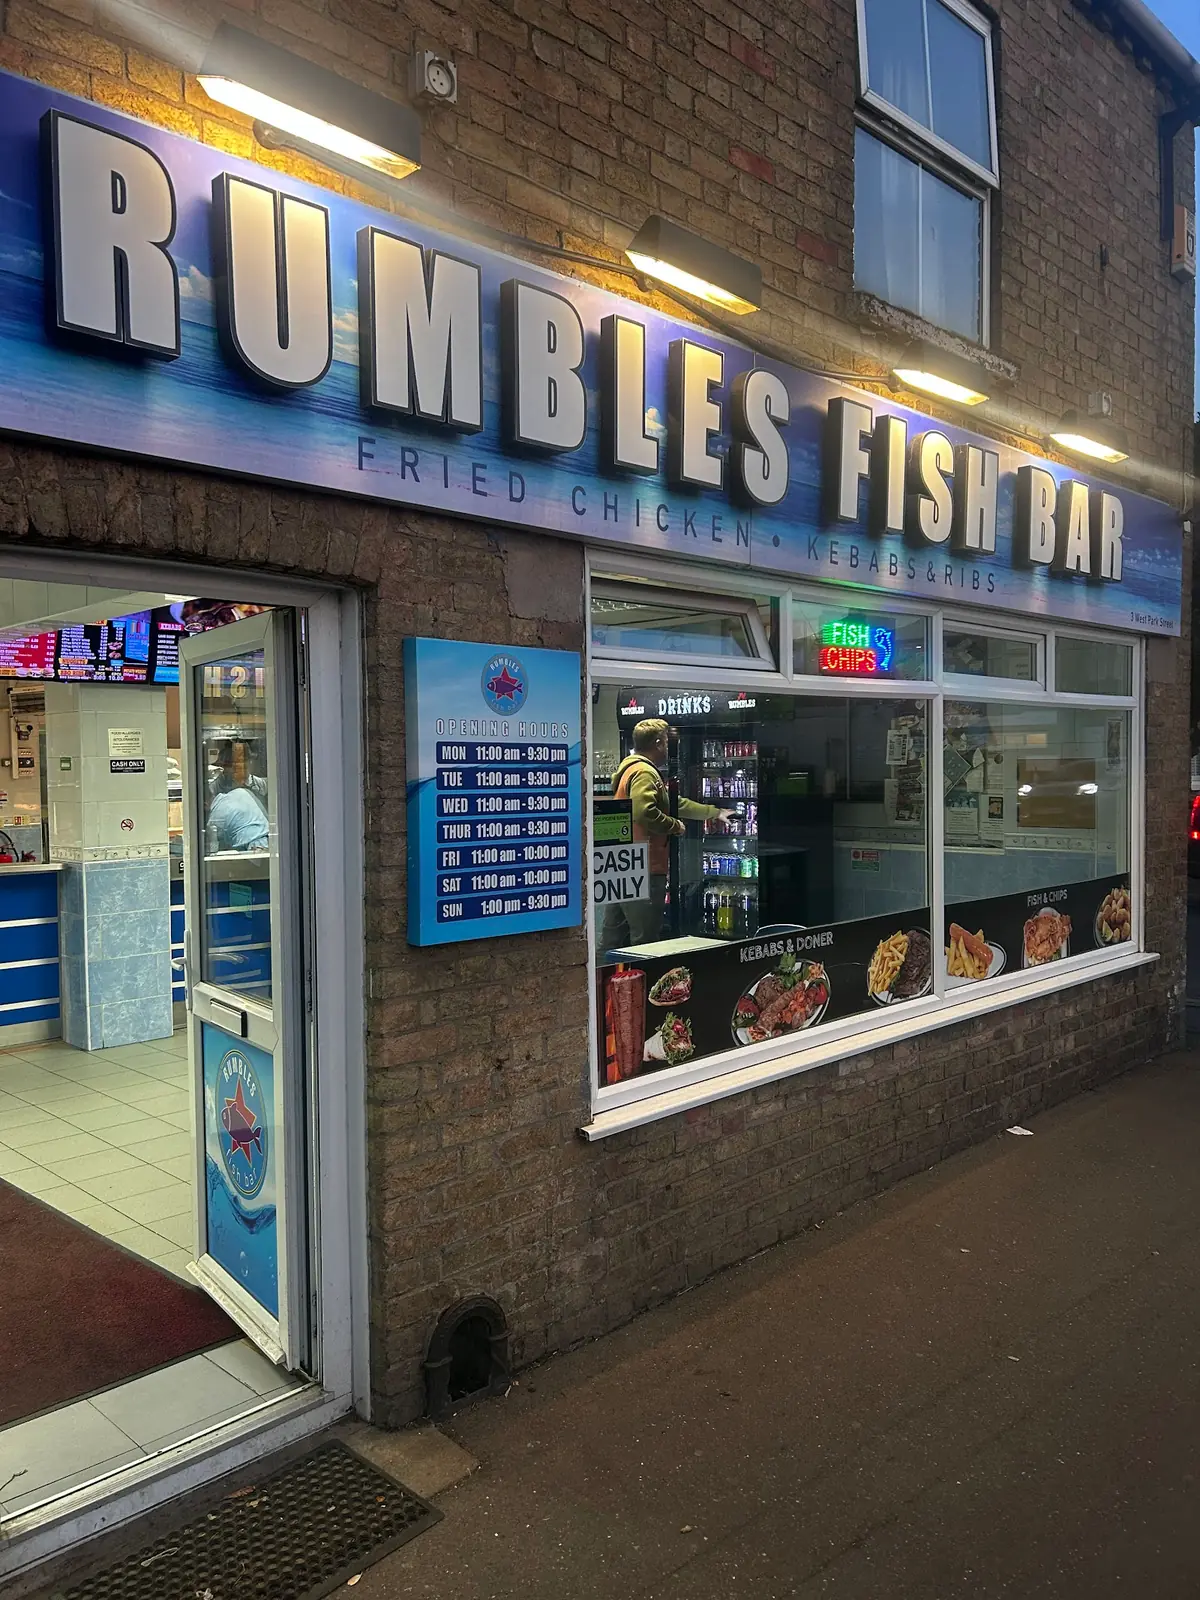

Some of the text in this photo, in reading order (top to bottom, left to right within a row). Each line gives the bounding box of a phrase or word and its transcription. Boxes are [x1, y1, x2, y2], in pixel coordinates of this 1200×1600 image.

[40, 108, 1124, 582] RUMBLES FISH BAR
[357, 436, 750, 548] FRIED CHICKEN
[1130, 611, 1174, 629] 3 West Park Street
[832, 622, 870, 648] FISH
[490, 658, 519, 672] RUMBLES
[826, 647, 877, 671] CHIPS
[621, 706, 645, 716] RUMBLES
[658, 695, 711, 716] DRINKS
[728, 699, 756, 710] RUMBLES
[436, 718, 569, 738] OPENING HOURS
[442, 746, 466, 761] MON
[476, 746, 502, 761] 11:00
[504, 748, 520, 760] am
[528, 746, 549, 761] 9:30
[551, 748, 566, 762] pm
[442, 772, 462, 787] TUE
[476, 772, 502, 786] 11:00
[504, 774, 520, 785] am
[528, 772, 549, 785] 9:30
[551, 773, 566, 786] pm
[443, 798, 468, 813] WED
[476, 797, 502, 812] 11:00
[504, 799, 520, 811] am
[528, 796, 549, 810] 9:30
[551, 798, 566, 811] pm
[443, 824, 471, 839] THUR
[476, 823, 502, 837] 11:00
[504, 824, 520, 836] am
[528, 821, 549, 835] 9:30
[551, 822, 566, 835] pm
[442, 851, 460, 866] FRI
[472, 849, 498, 864] 11:00
[500, 850, 516, 862] am
[524, 846, 549, 861] 10:00
[551, 846, 566, 860] pm
[593, 847, 645, 875] CASH
[443, 877, 461, 892] SAT
[472, 875, 498, 890] 11:00
[500, 876, 516, 888] am
[524, 871, 549, 886] 10:00
[551, 870, 566, 884] pm
[593, 875, 645, 903] ONLY
[443, 902, 462, 918] SUN
[481, 900, 502, 915] 1:00
[504, 900, 520, 914] pm
[528, 896, 549, 910] 9:30
[551, 894, 566, 908] pm
[1027, 889, 1068, 907] FISH & CHIPS
[740, 931, 834, 963] KEBABS & DONER
[223, 1058, 257, 1097] RUMBLES
